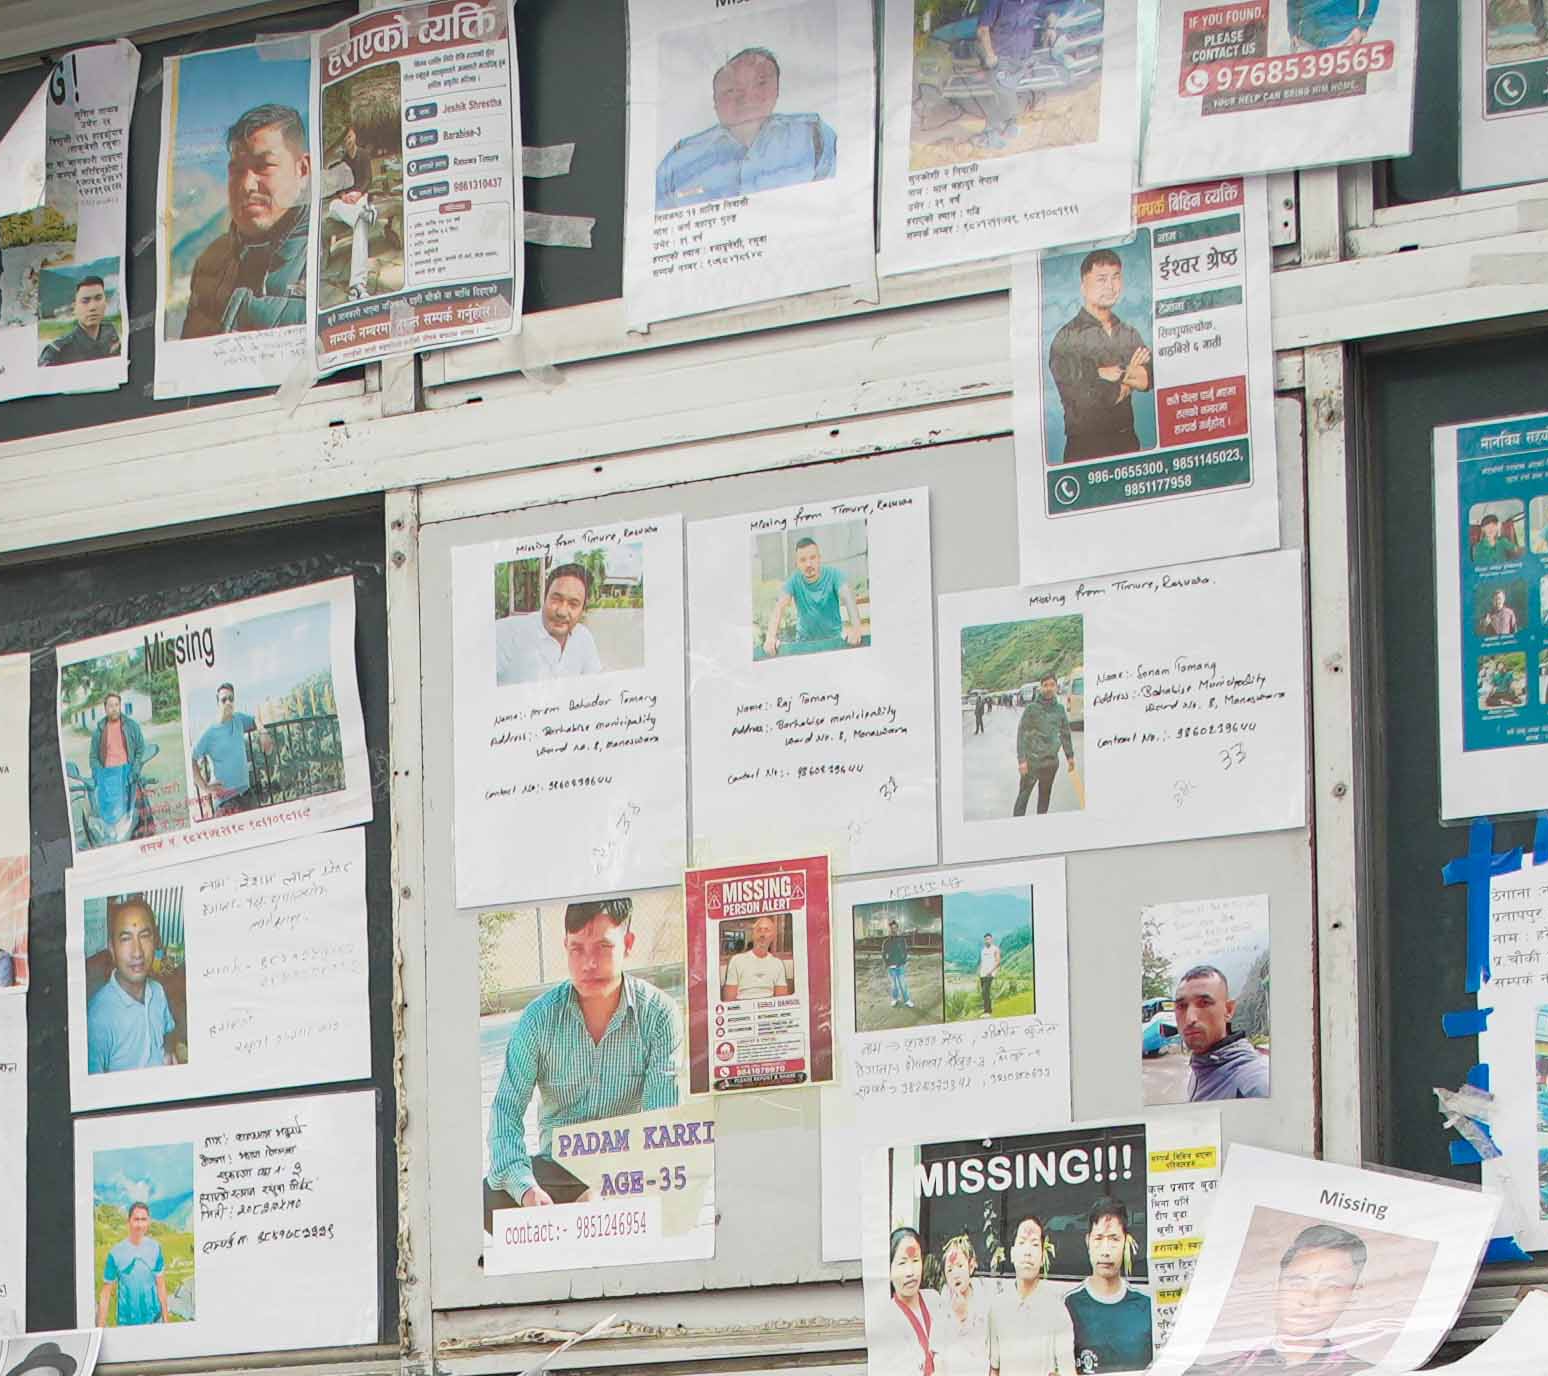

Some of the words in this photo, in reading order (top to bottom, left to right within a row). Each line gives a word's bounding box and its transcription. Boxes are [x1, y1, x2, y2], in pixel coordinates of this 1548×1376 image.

[328, 15, 409, 77] हराएको
[418, 1, 497, 45] व्यक्ति
[1192, 45, 1236, 63] CONTACT
[1240, 41, 1256, 57] US
[1204, 30, 1244, 47] PLEASE
[1216, 44, 1385, 91] 9768539565
[1124, 473, 1192, 498] 9851177958
[1076, 584, 1106, 600] from
[142, 624, 215, 676] Missing
[723, 876, 792, 903] MISSING
[723, 902, 759, 916] PERSON
[761, 898, 791, 912] ALERT
[558, 1129, 630, 1157] PADAM
[643, 1121, 715, 1149] KARKI
[600, 1166, 686, 1197] AGE-35
[916, 1143, 1135, 1199] MISSING!!!
[1318, 1184, 1390, 1222] Missing
[505, 1221, 568, 1246] contact:-
[576, 1212, 646, 1240] 9851246954
